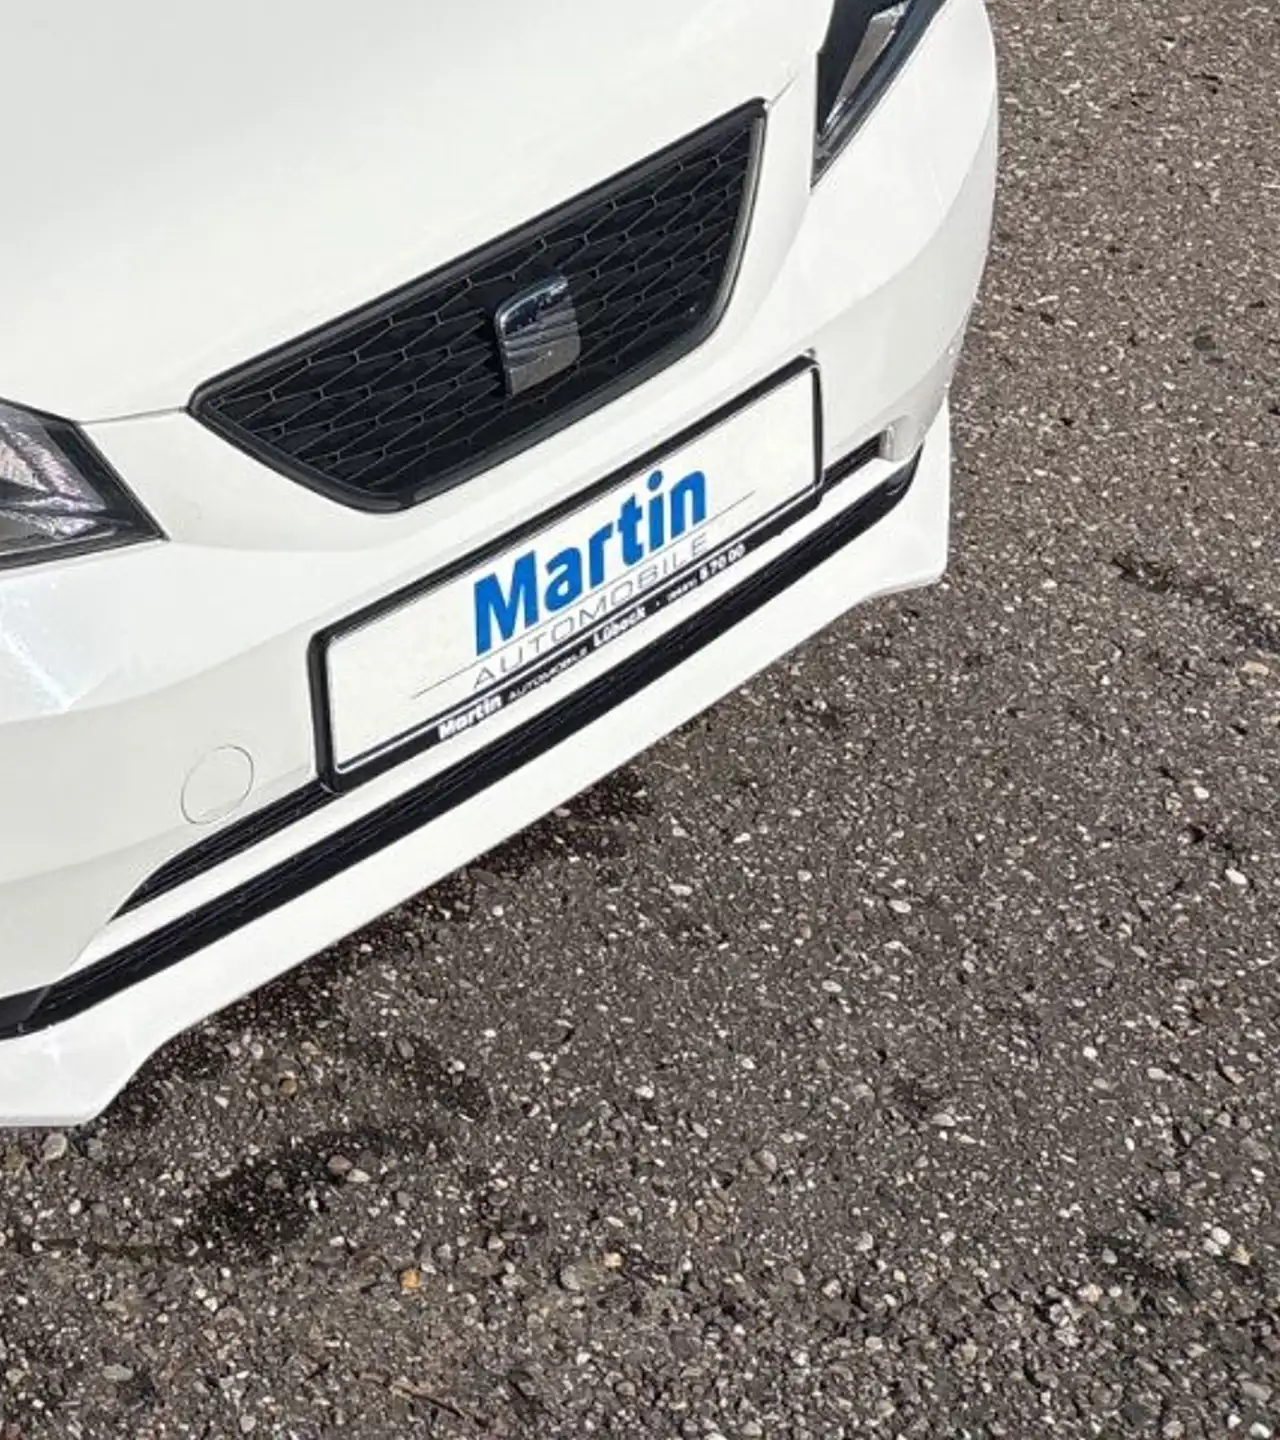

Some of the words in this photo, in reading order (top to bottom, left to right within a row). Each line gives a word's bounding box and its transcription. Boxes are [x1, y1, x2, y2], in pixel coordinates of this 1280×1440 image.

[473, 532, 707, 690] AUTOMOBILE
[475, 470, 706, 655] Martin
[438, 694, 503, 739] Martin
